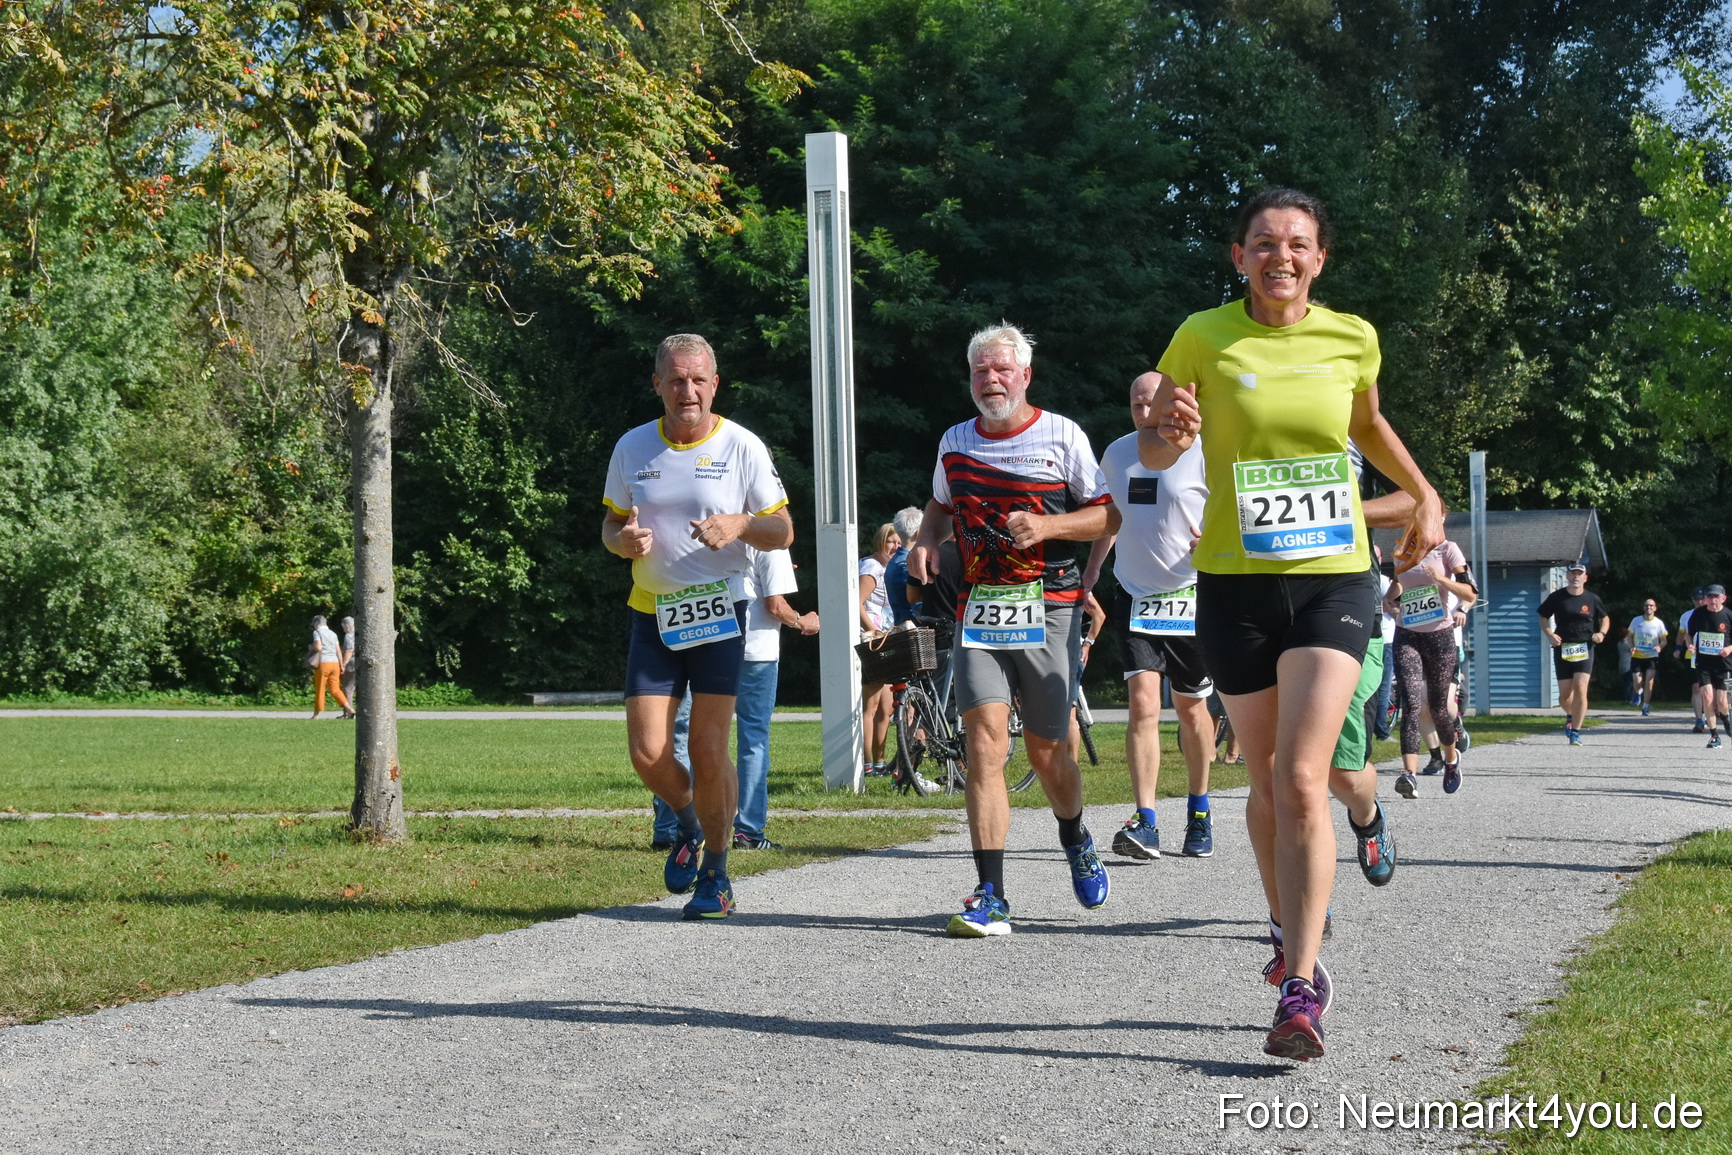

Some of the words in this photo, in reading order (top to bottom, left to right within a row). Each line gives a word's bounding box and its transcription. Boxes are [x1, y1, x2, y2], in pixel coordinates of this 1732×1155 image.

[696, 457, 711, 467] 20
[1243, 458, 1341, 489] BOCK
[1252, 490, 1336, 526] 2211
[1272, 531, 1327, 549] AGNES
[1403, 586, 1437, 600] BOCK
[665, 597, 726, 627] 2356
[1139, 601, 1188, 616] 2717
[1405, 597, 1437, 615] 2246
[973, 605, 1032, 626] 2321
[1409, 612, 1437, 622] LARISSA
[679, 625, 720, 641] GEORG
[1142, 621, 1190, 630] WOLFGANG
[981, 631, 1027, 641] STEFAN
[1701, 640, 1720, 648] 2619
